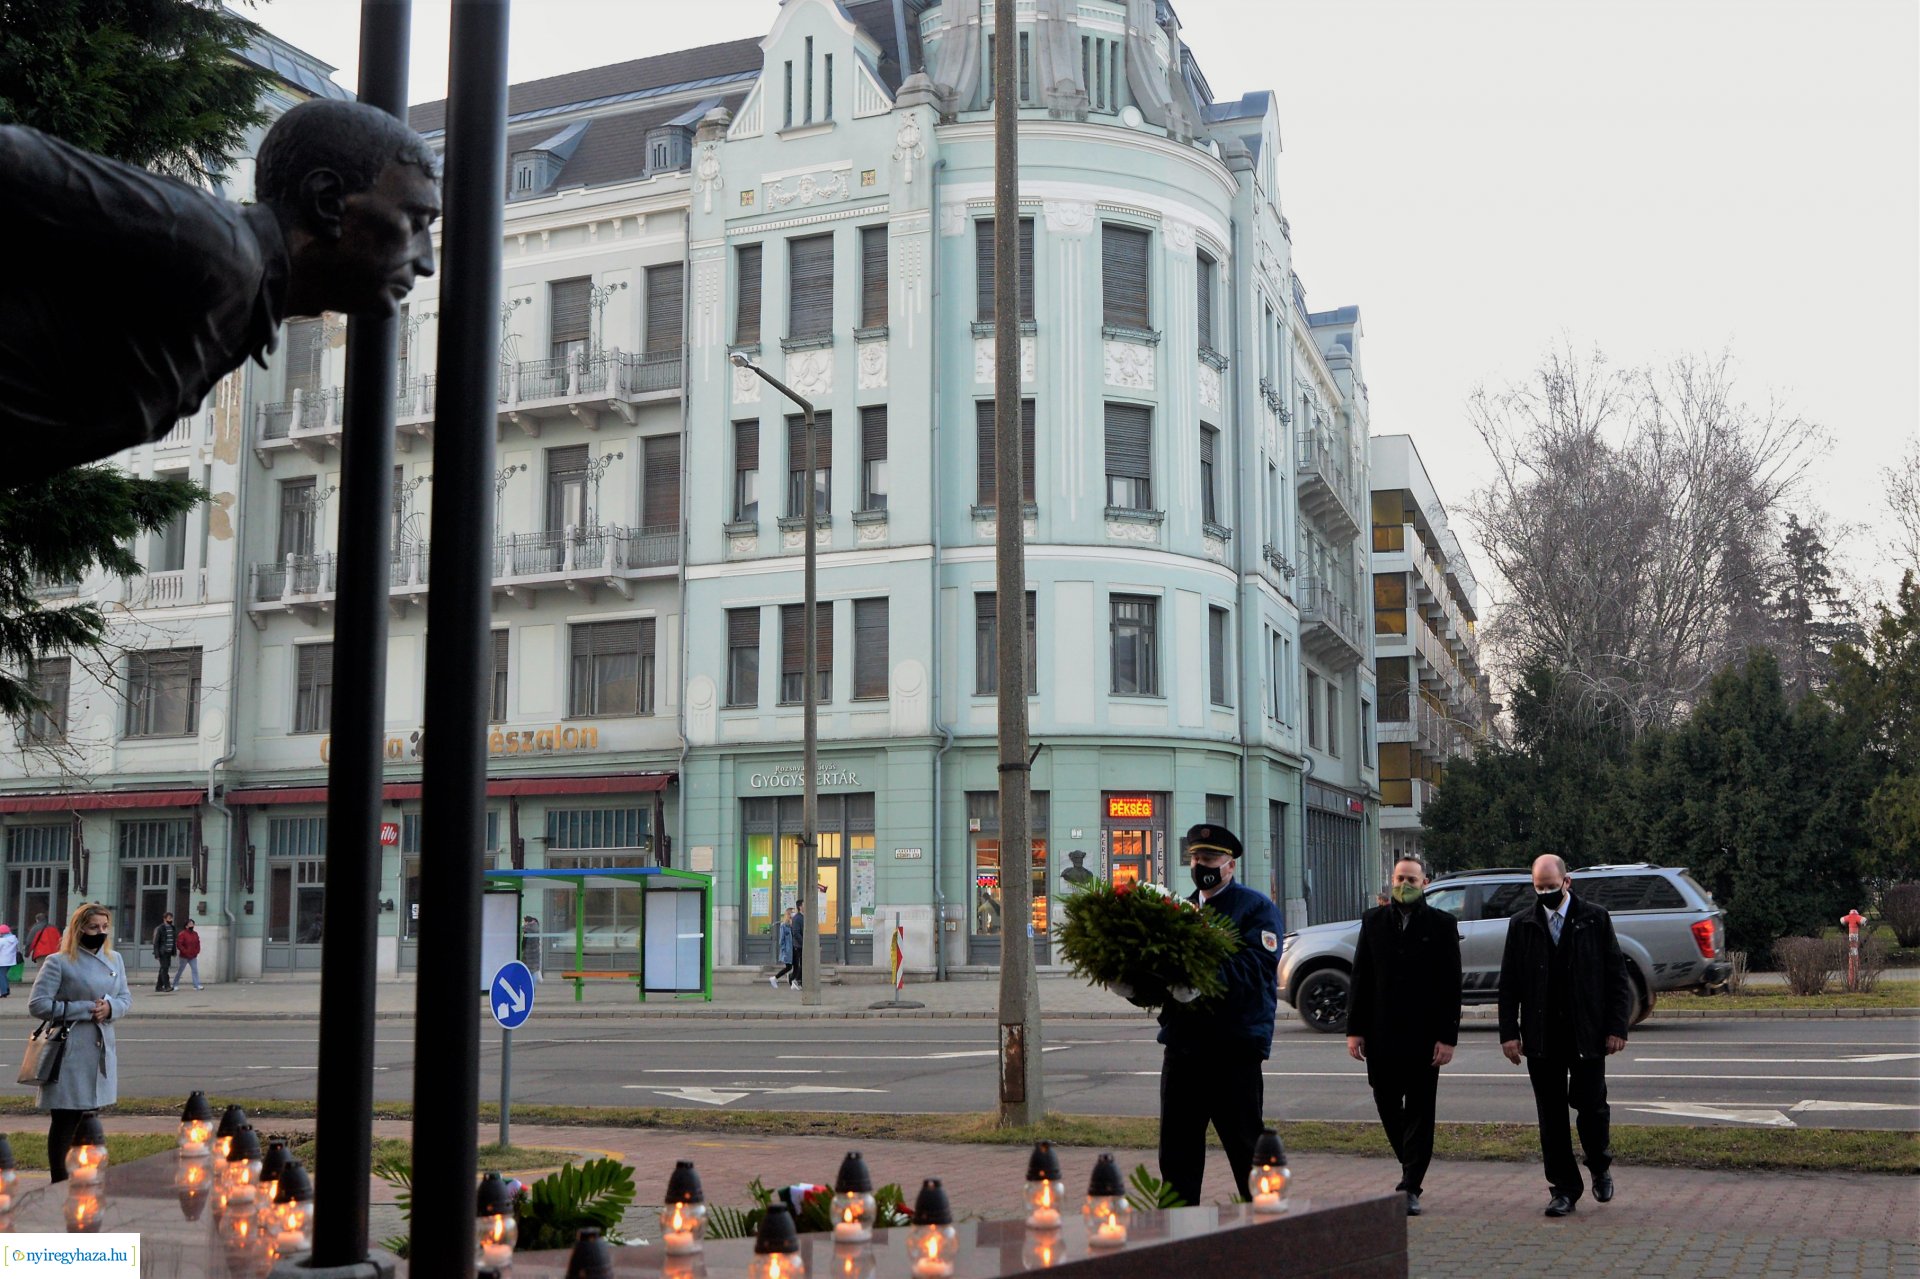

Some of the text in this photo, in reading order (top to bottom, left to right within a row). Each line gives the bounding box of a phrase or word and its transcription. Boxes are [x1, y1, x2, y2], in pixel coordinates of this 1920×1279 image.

[489, 725, 598, 753] észalon
[817, 762, 837, 772] átyás
[751, 769, 861, 788] GYÓGYSERTÁR
[1111, 800, 1150, 815] PÉKSÉG
[381, 825, 397, 844] illy
